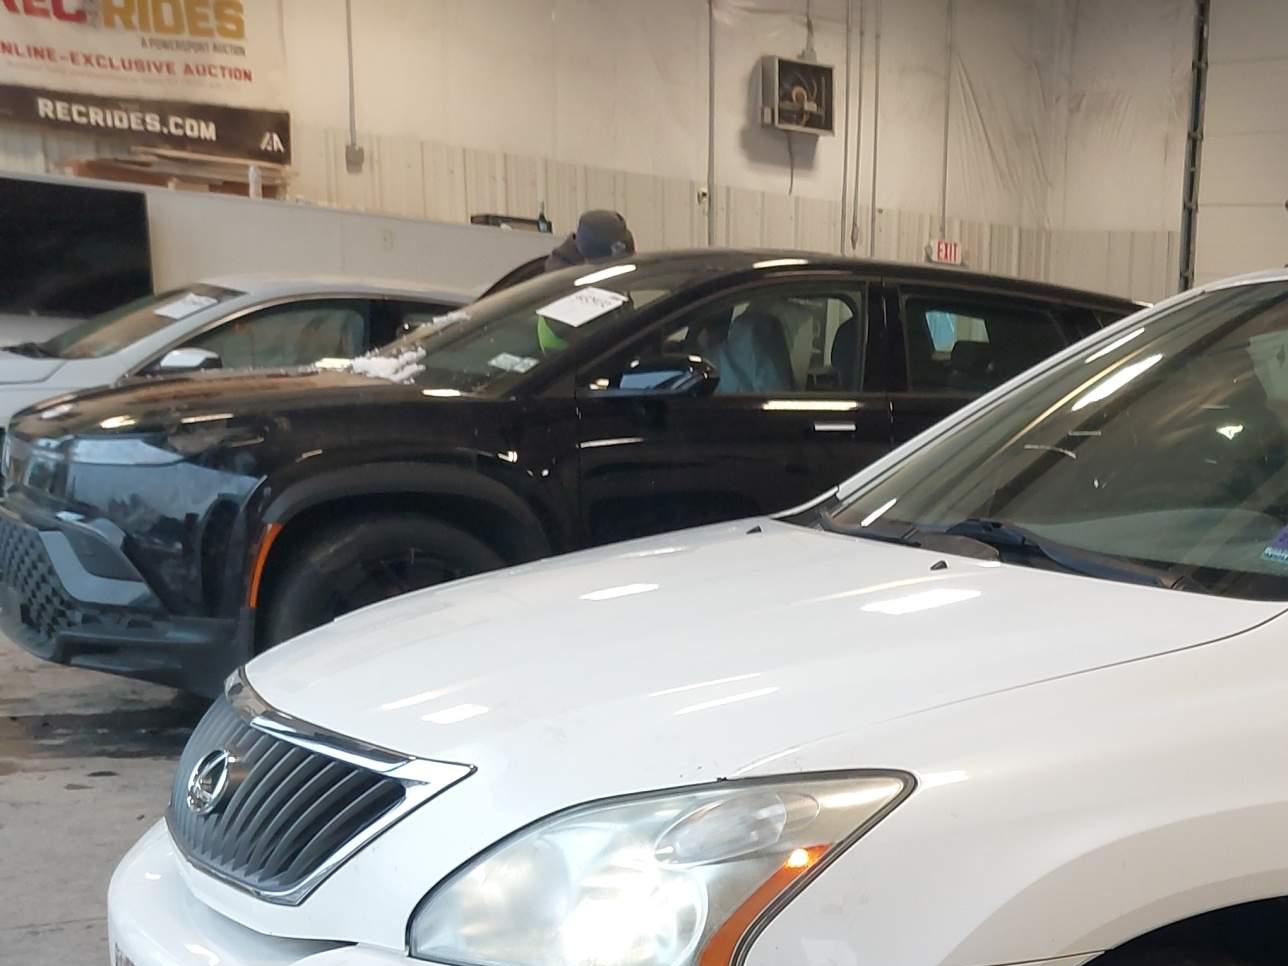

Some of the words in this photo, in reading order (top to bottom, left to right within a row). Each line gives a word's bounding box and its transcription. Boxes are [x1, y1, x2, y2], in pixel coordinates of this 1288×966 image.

[102, 0, 246, 40] RIDES
[0, 40, 176, 76] NLINE-EXCLUSIVE
[183, 63, 253, 82] AUCTION
[37, 97, 217, 142] RECRIDES.COM
[937, 240, 958, 262] EXIT
